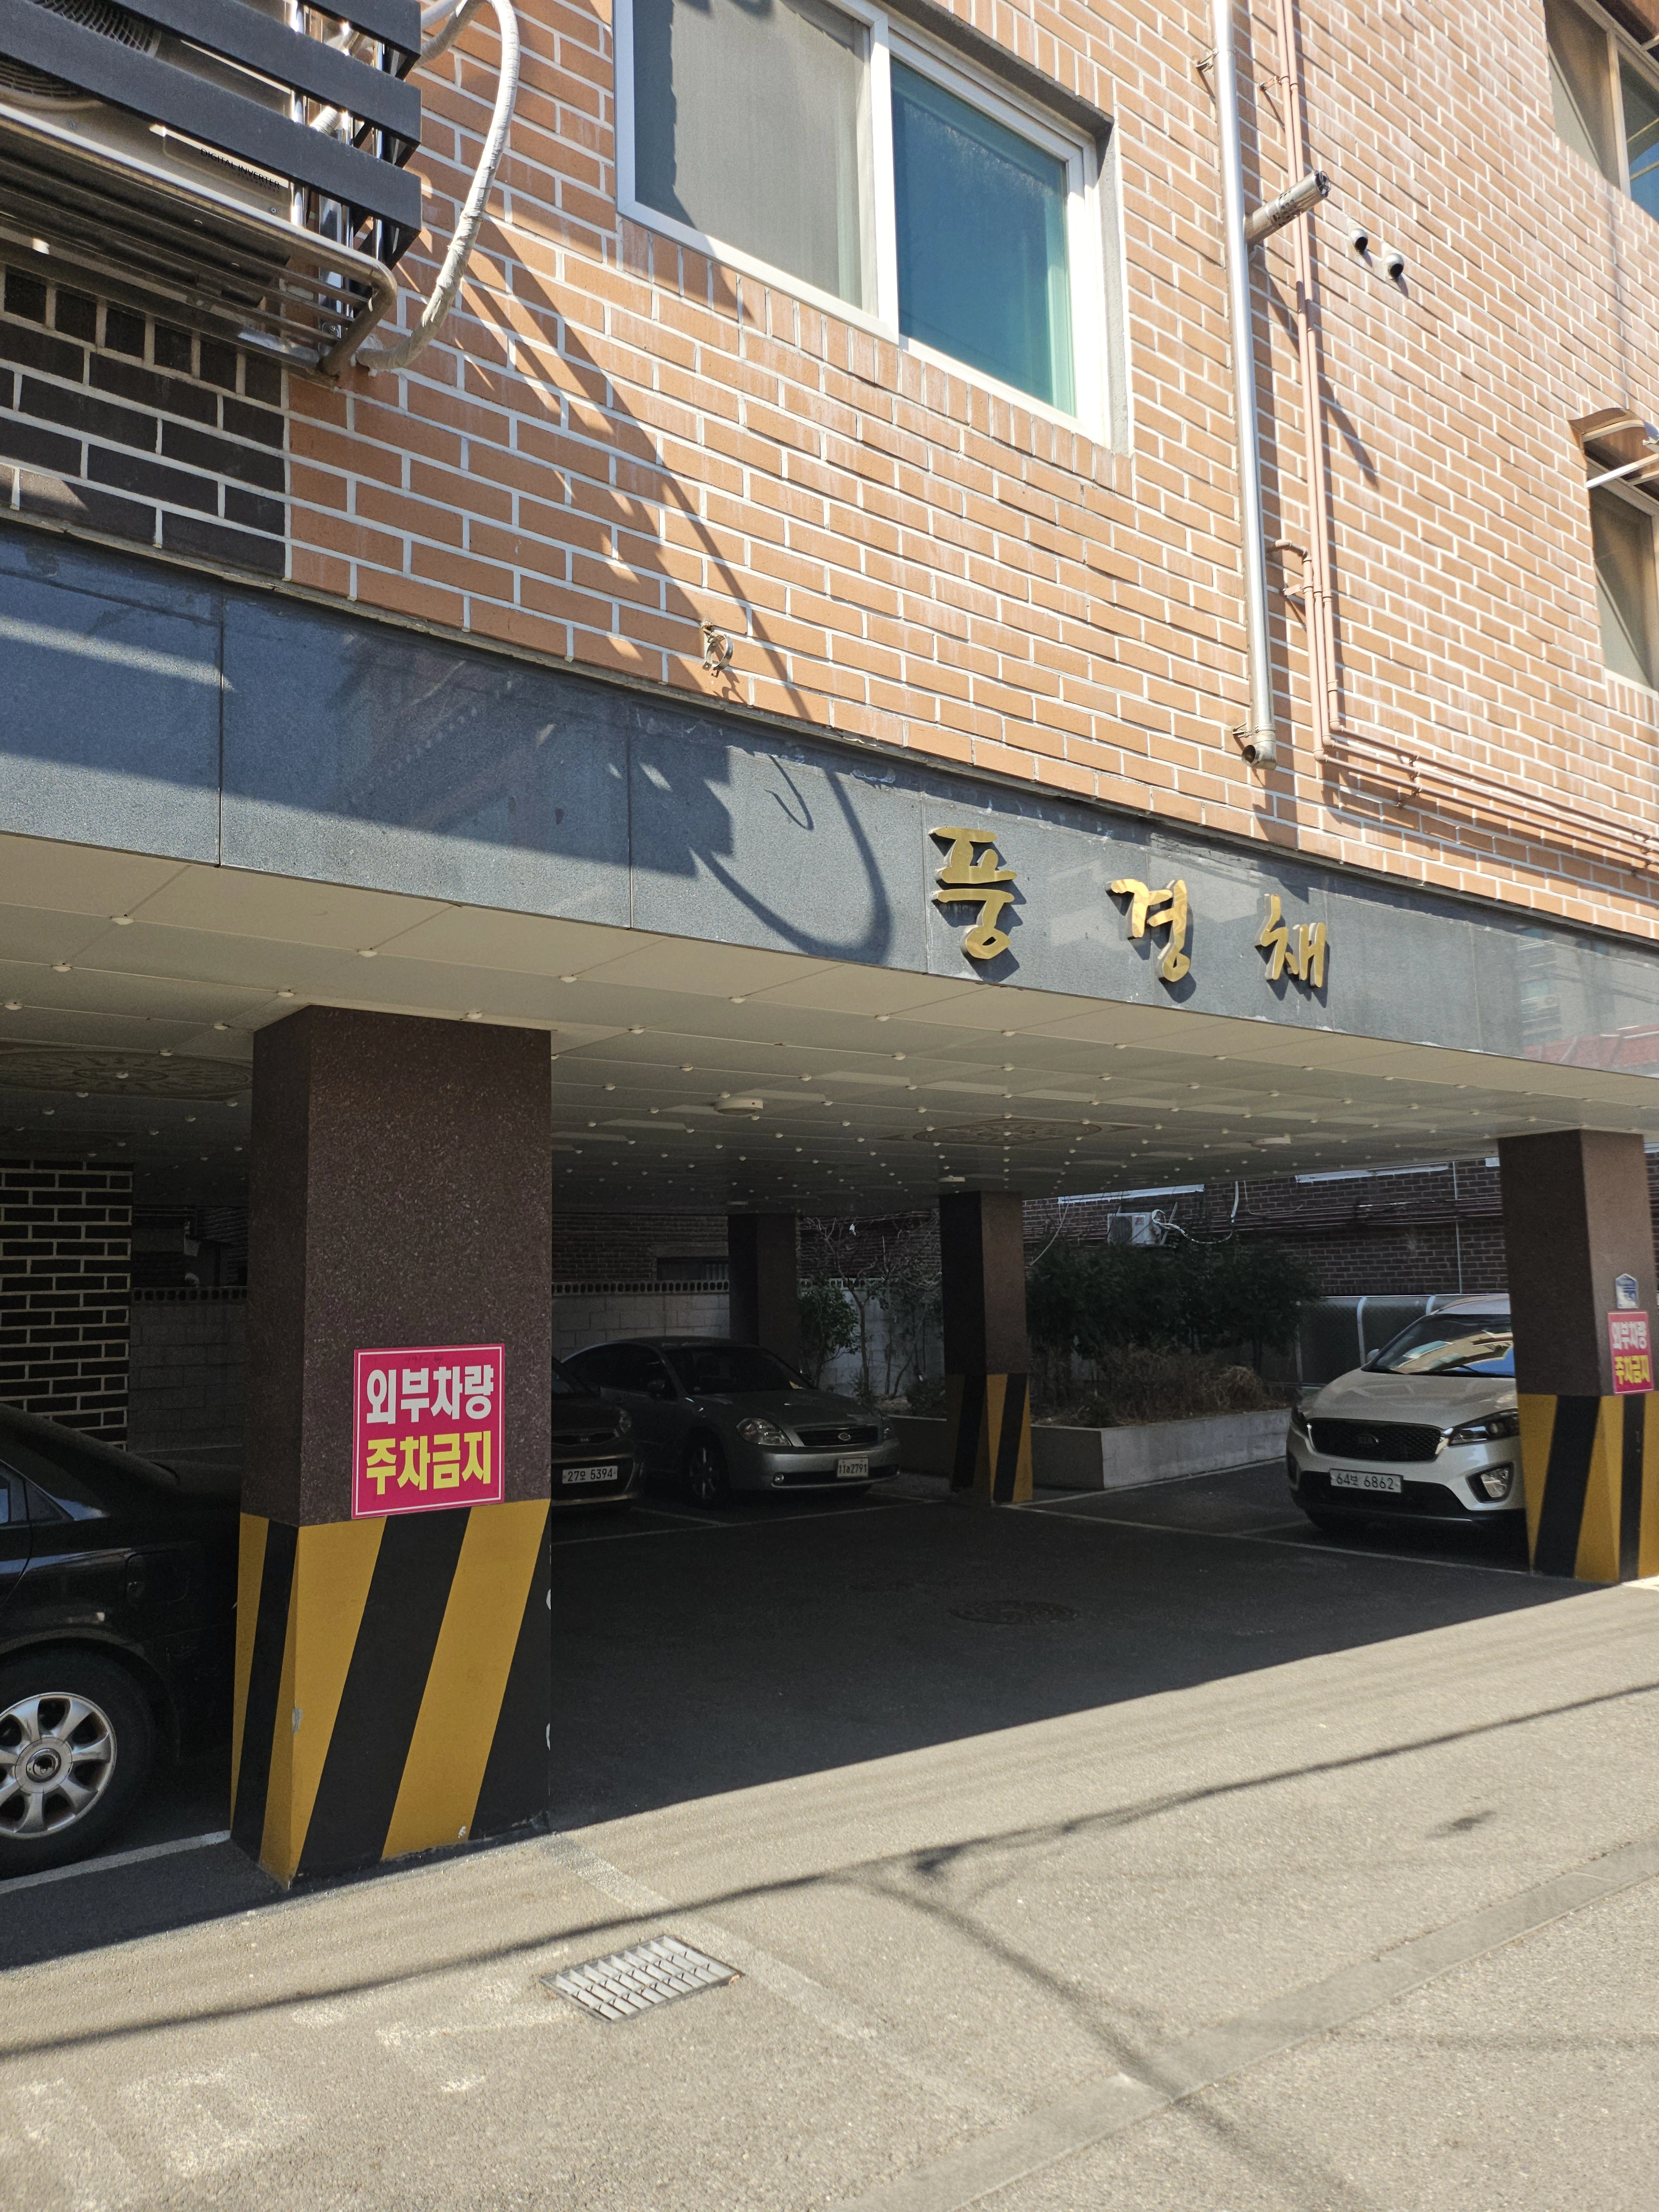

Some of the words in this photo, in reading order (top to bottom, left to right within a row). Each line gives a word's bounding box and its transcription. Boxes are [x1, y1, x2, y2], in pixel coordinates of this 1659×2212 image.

[201, 148, 236, 170] DIGITAL
[238, 165, 280, 189] INVERTER
[929, 826, 1326, 988] 풍경채
[367, 1364, 494, 1425] 외부차량
[366, 1430, 491, 1495] 주차금지
[590, 1468, 613, 1480] 5394
[1364, 1475, 1394, 1490] 6862
